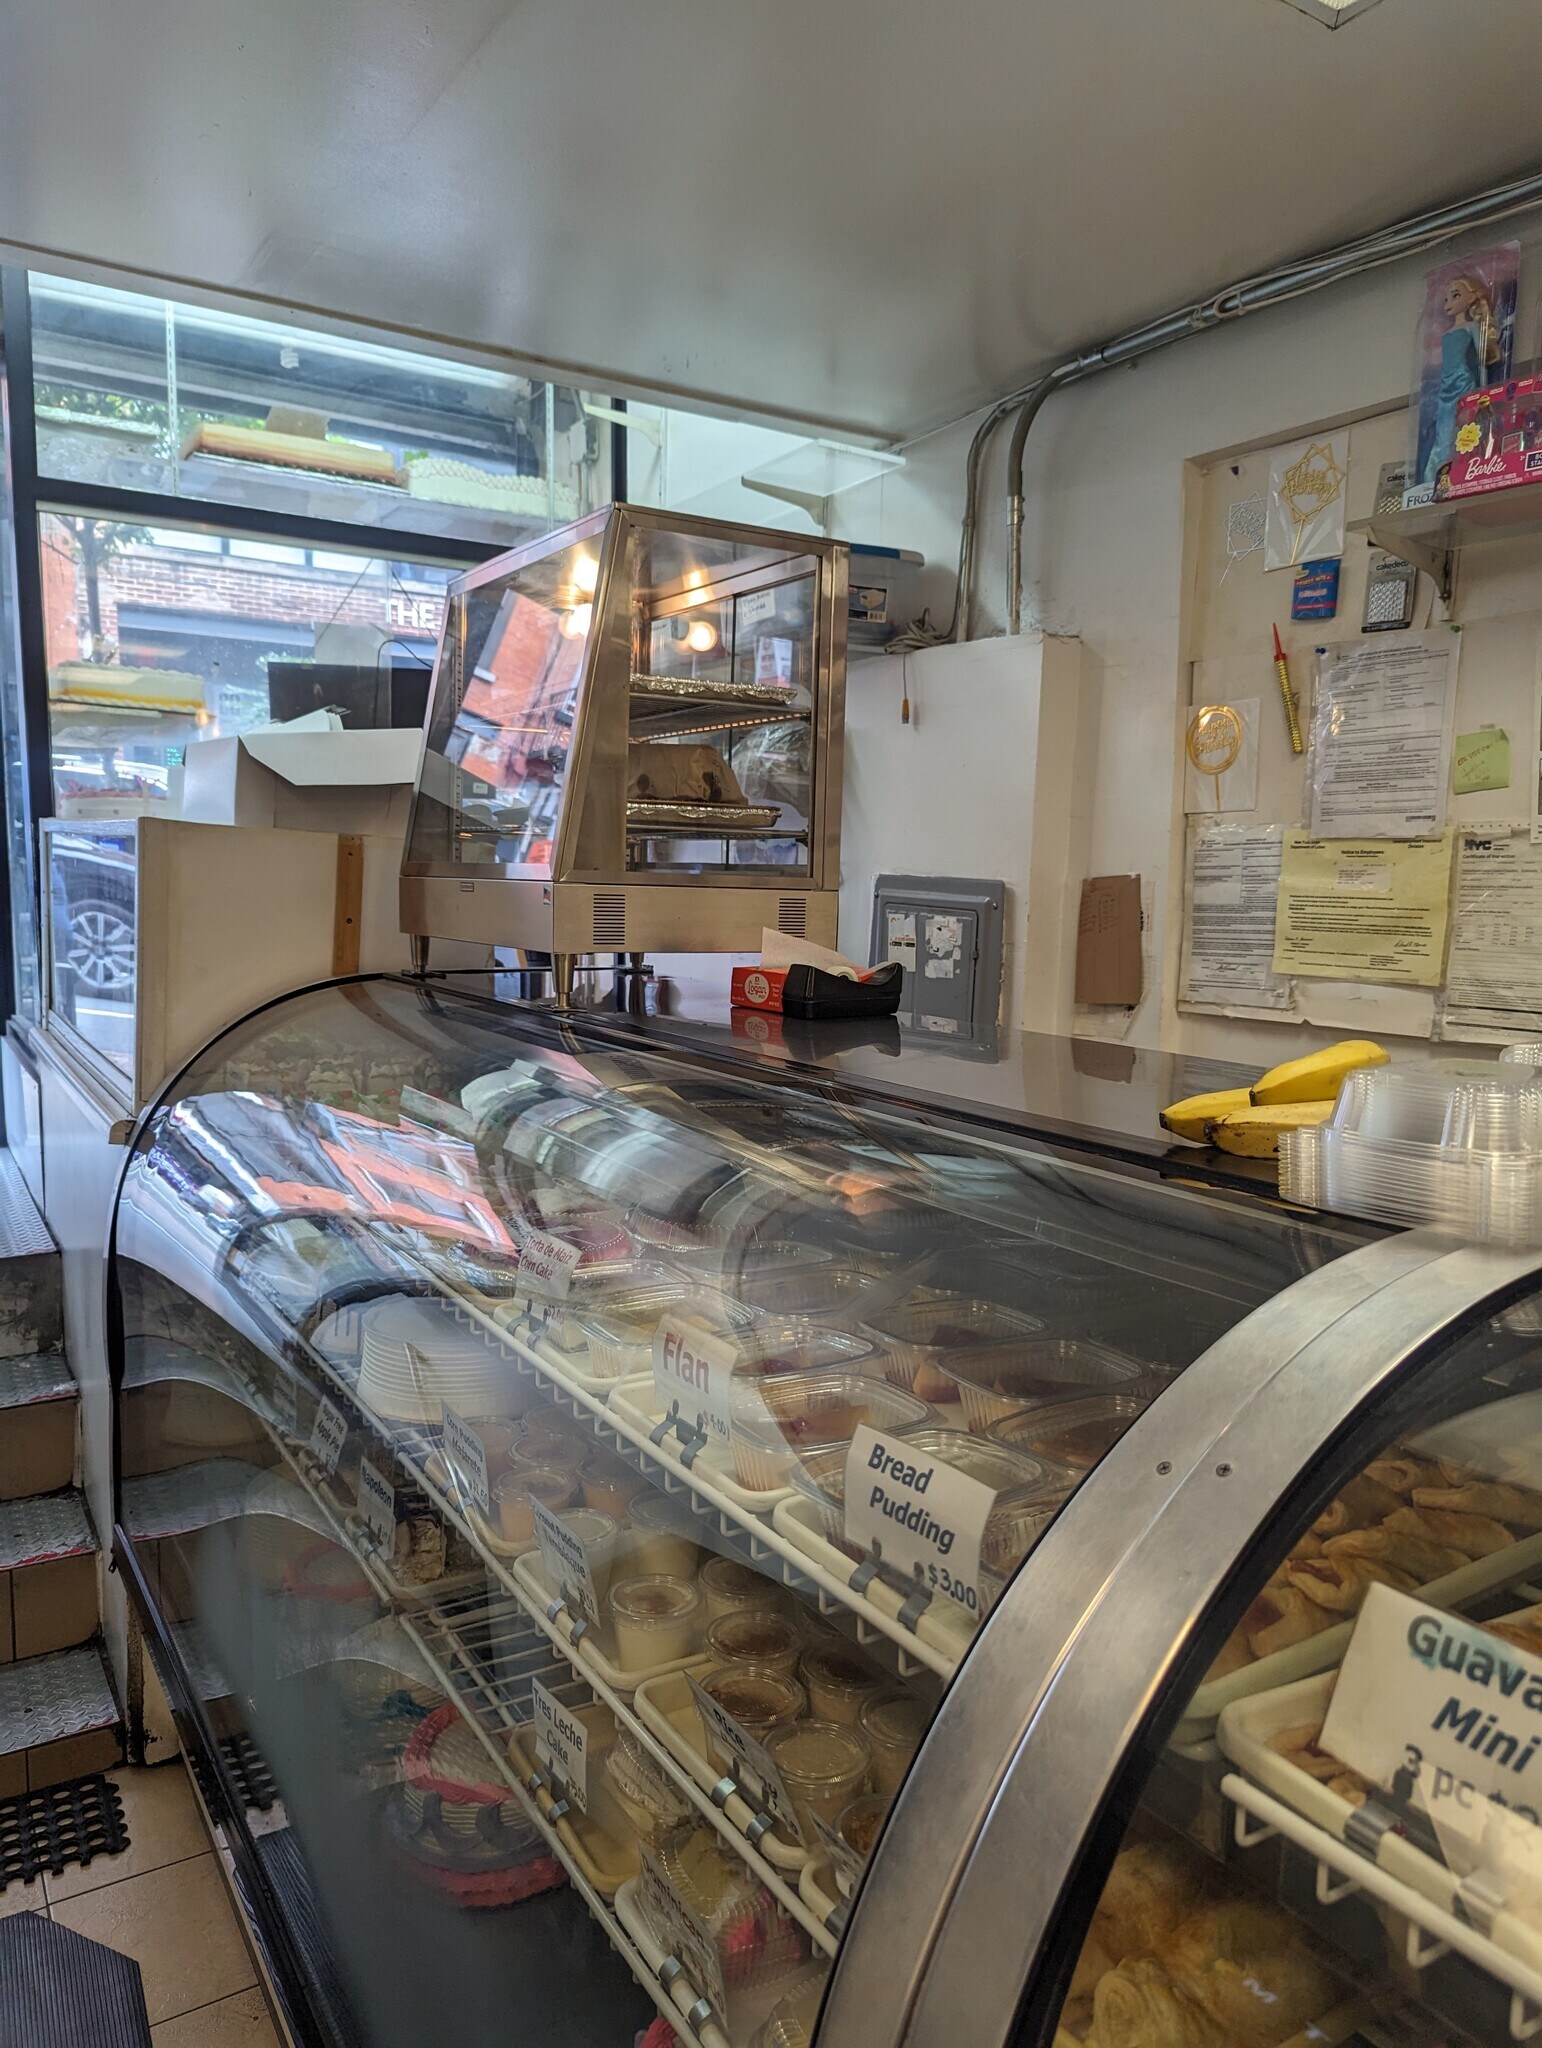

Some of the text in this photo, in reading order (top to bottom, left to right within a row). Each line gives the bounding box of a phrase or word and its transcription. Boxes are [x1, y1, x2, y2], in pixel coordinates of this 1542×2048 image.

[1465, 455, 1507, 480] Barbie
[378, 597, 437, 629] THE
[1464, 839, 1492, 851] NYC
[520, 1255, 553, 1280] Corn Cake
[528, 1235, 545, 1253] Torta
[543, 1242, 554, 1257] de
[663, 1331, 710, 1394] Flan
[362, 1464, 393, 1508] Napoleon
[867, 1443, 934, 1494] Bread
[869, 1485, 956, 1555] Pudding
[927, 1562, 977, 1610] $3.00
[1407, 1614, 1542, 1714] Guava
[533, 1687, 583, 1753] Tres Leche
[1431, 1696, 1542, 1775] Mini
[547, 1729, 569, 1765] Cake
[1404, 1743, 1423, 1779] 3
[1432, 1766, 1476, 1810] pc
[641, 1852, 706, 1951] Dominican
